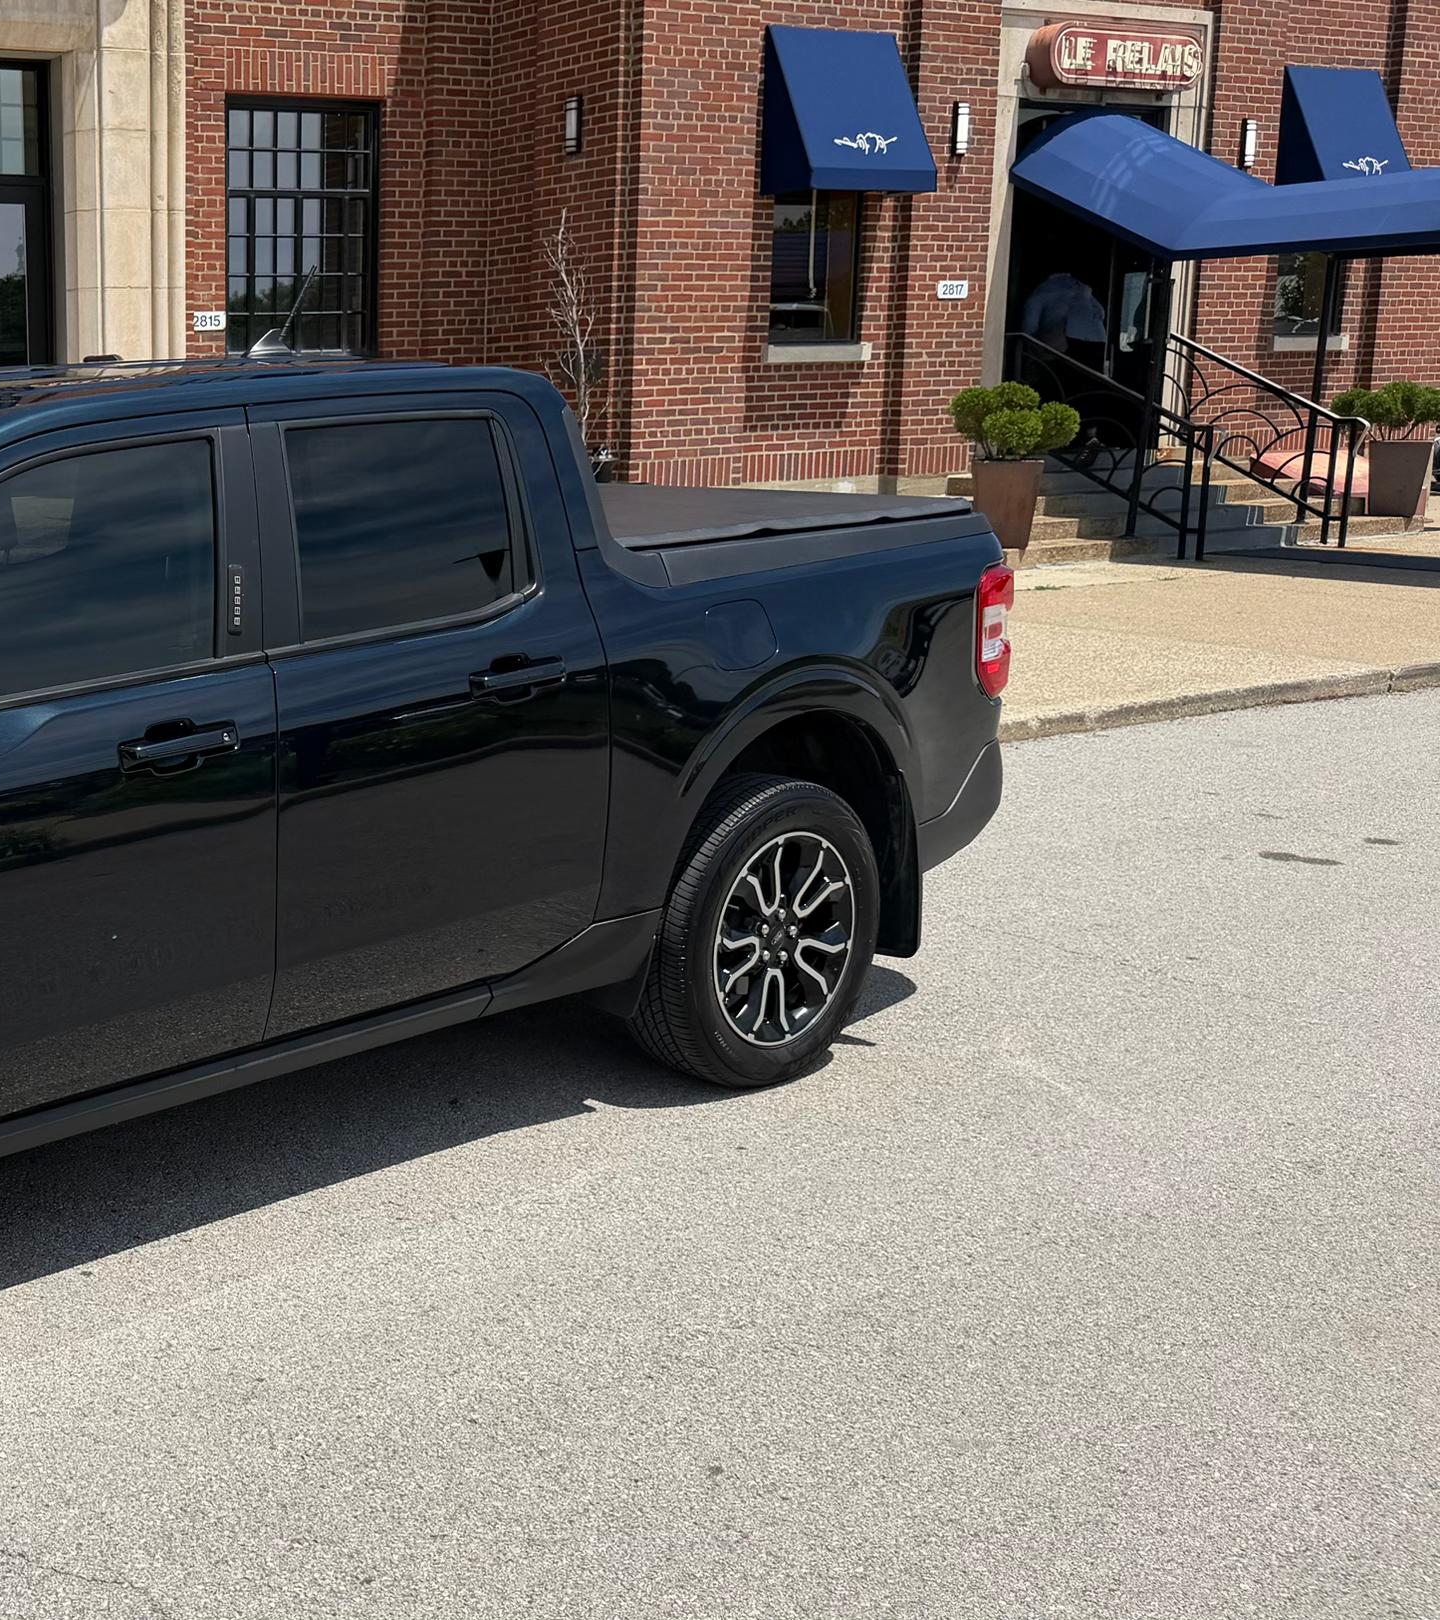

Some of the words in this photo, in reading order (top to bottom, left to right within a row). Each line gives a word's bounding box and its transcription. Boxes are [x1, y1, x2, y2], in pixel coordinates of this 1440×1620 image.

[1061, 35, 1098, 71] LE
[1105, 38, 1203, 78] RELAIS
[942, 283, 964, 296] 2817
[192, 314, 221, 328] 2815
